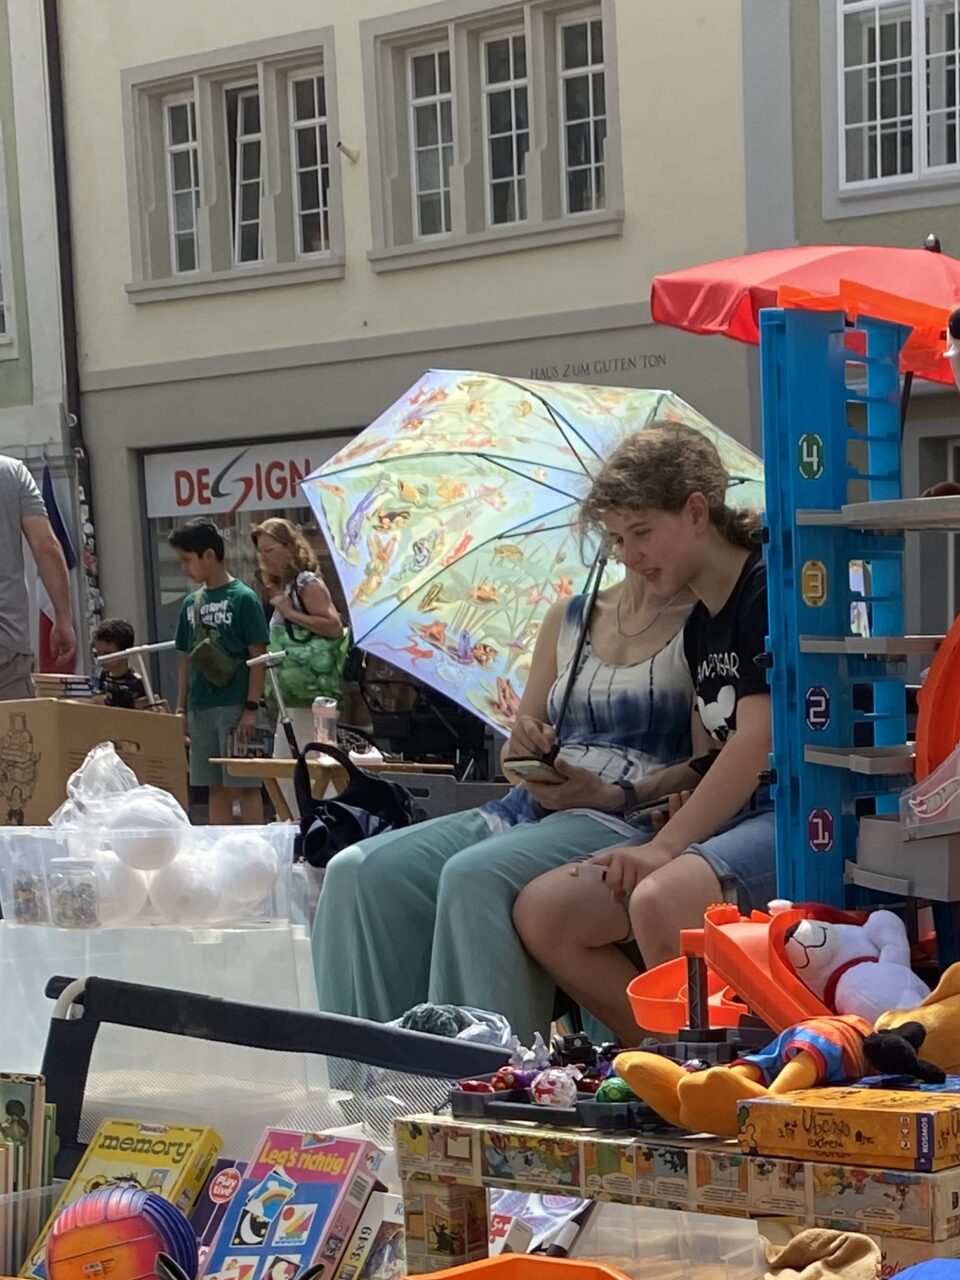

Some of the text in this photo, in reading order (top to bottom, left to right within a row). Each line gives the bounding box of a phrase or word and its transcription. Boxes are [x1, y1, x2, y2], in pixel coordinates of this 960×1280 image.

[530, 353, 667, 380] HAUS ZUM GUTEN TON
[98, 1134, 192, 1164] memory
[921, 1116, 929, 1153] KOSMOS
